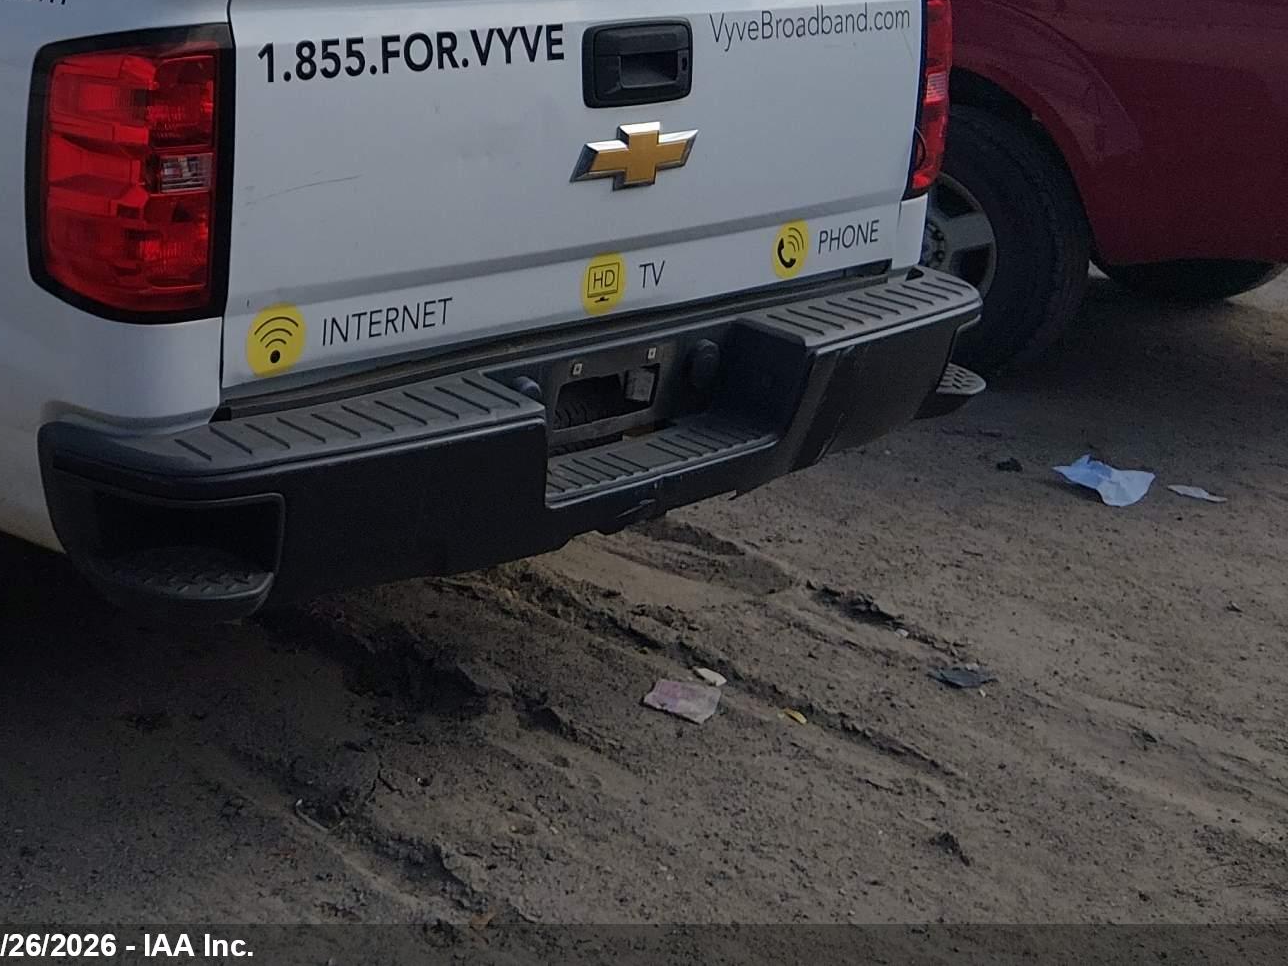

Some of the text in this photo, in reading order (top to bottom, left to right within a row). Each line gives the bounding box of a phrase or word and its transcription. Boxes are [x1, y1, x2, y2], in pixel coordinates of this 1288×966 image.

[709, 2, 910, 52] VyveBroadband.com
[257, 23, 565, 84] 1.855.FOR.VYVE
[818, 219, 880, 255] PHONE
[639, 260, 665, 289] TV
[321, 297, 453, 347] INTERNET
